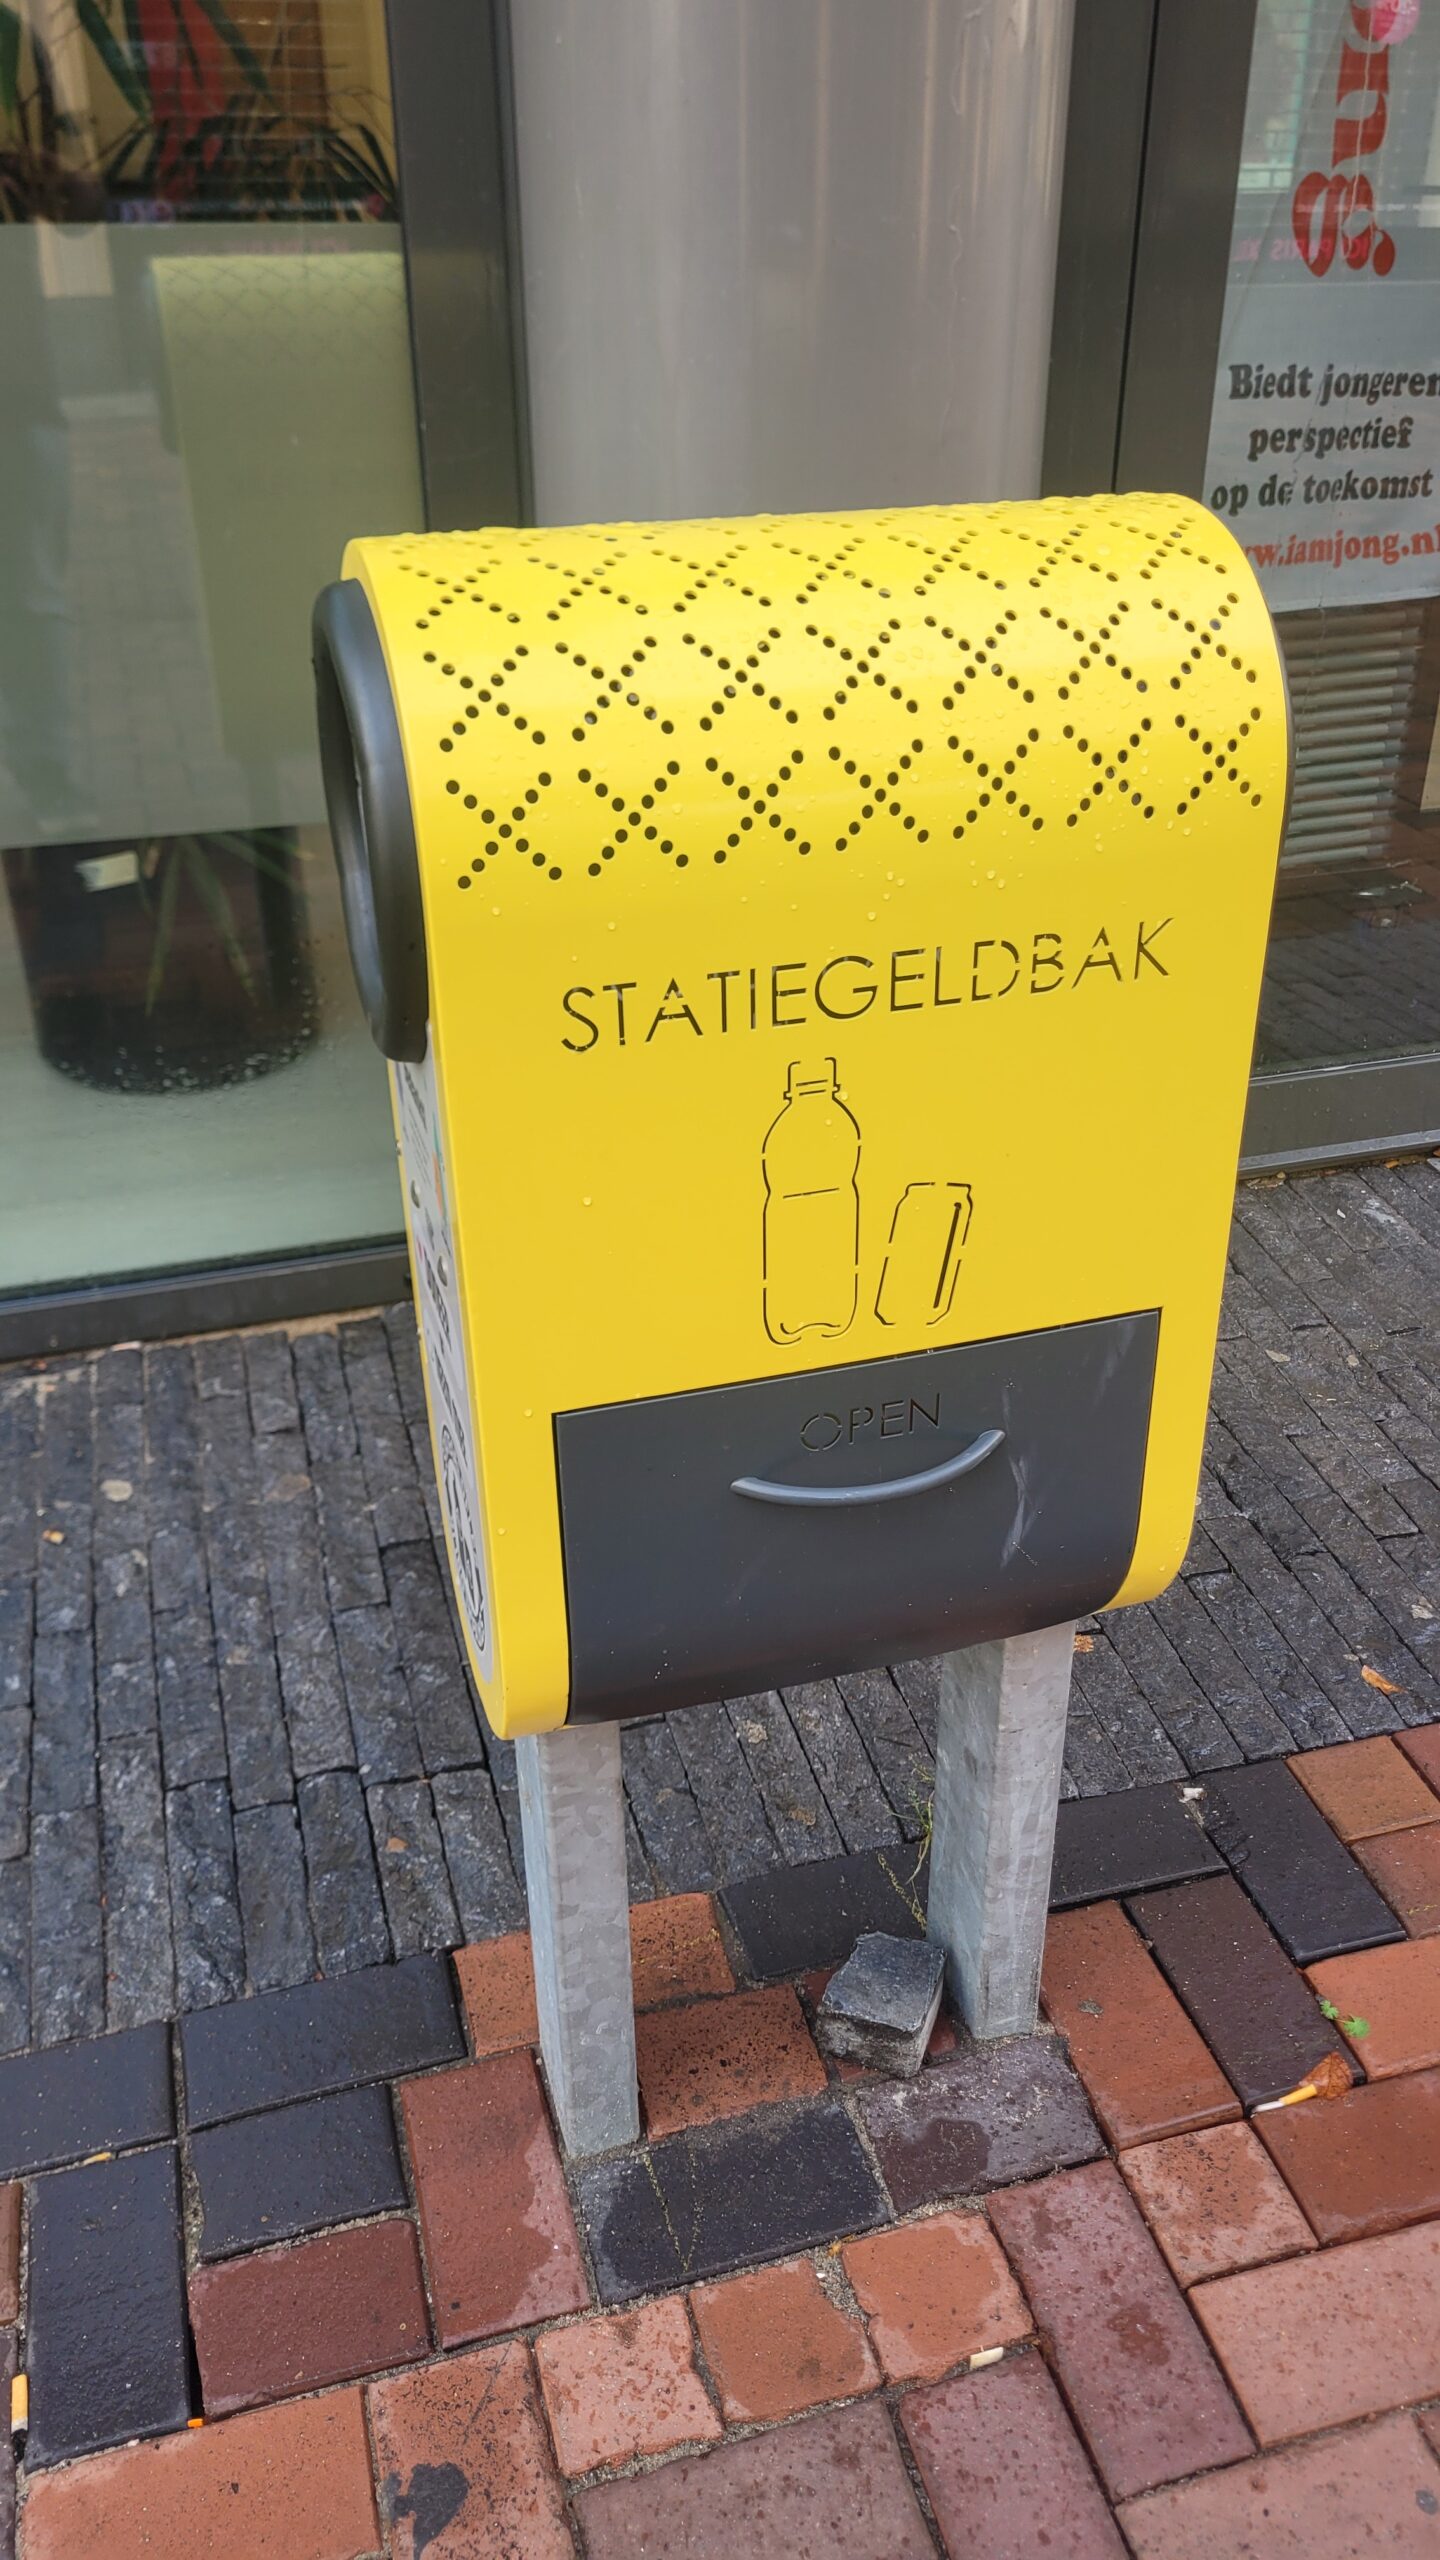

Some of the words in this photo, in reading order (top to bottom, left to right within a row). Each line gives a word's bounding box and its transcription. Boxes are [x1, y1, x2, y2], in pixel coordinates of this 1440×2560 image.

[1229, 363, 1313, 399] Biedt
[1319, 363, 1440, 406] jongeren
[1247, 415, 1414, 462] perspectief
[1211, 482, 1249, 516] op
[1258, 474, 1293, 507] de
[1303, 468, 1434, 505] toekomst
[1244, 523, 1440, 568] w.iamjong.n
[561, 916, 1175, 1054] STATIEGELDBAK
[800, 1392, 941, 1452] OPEN
